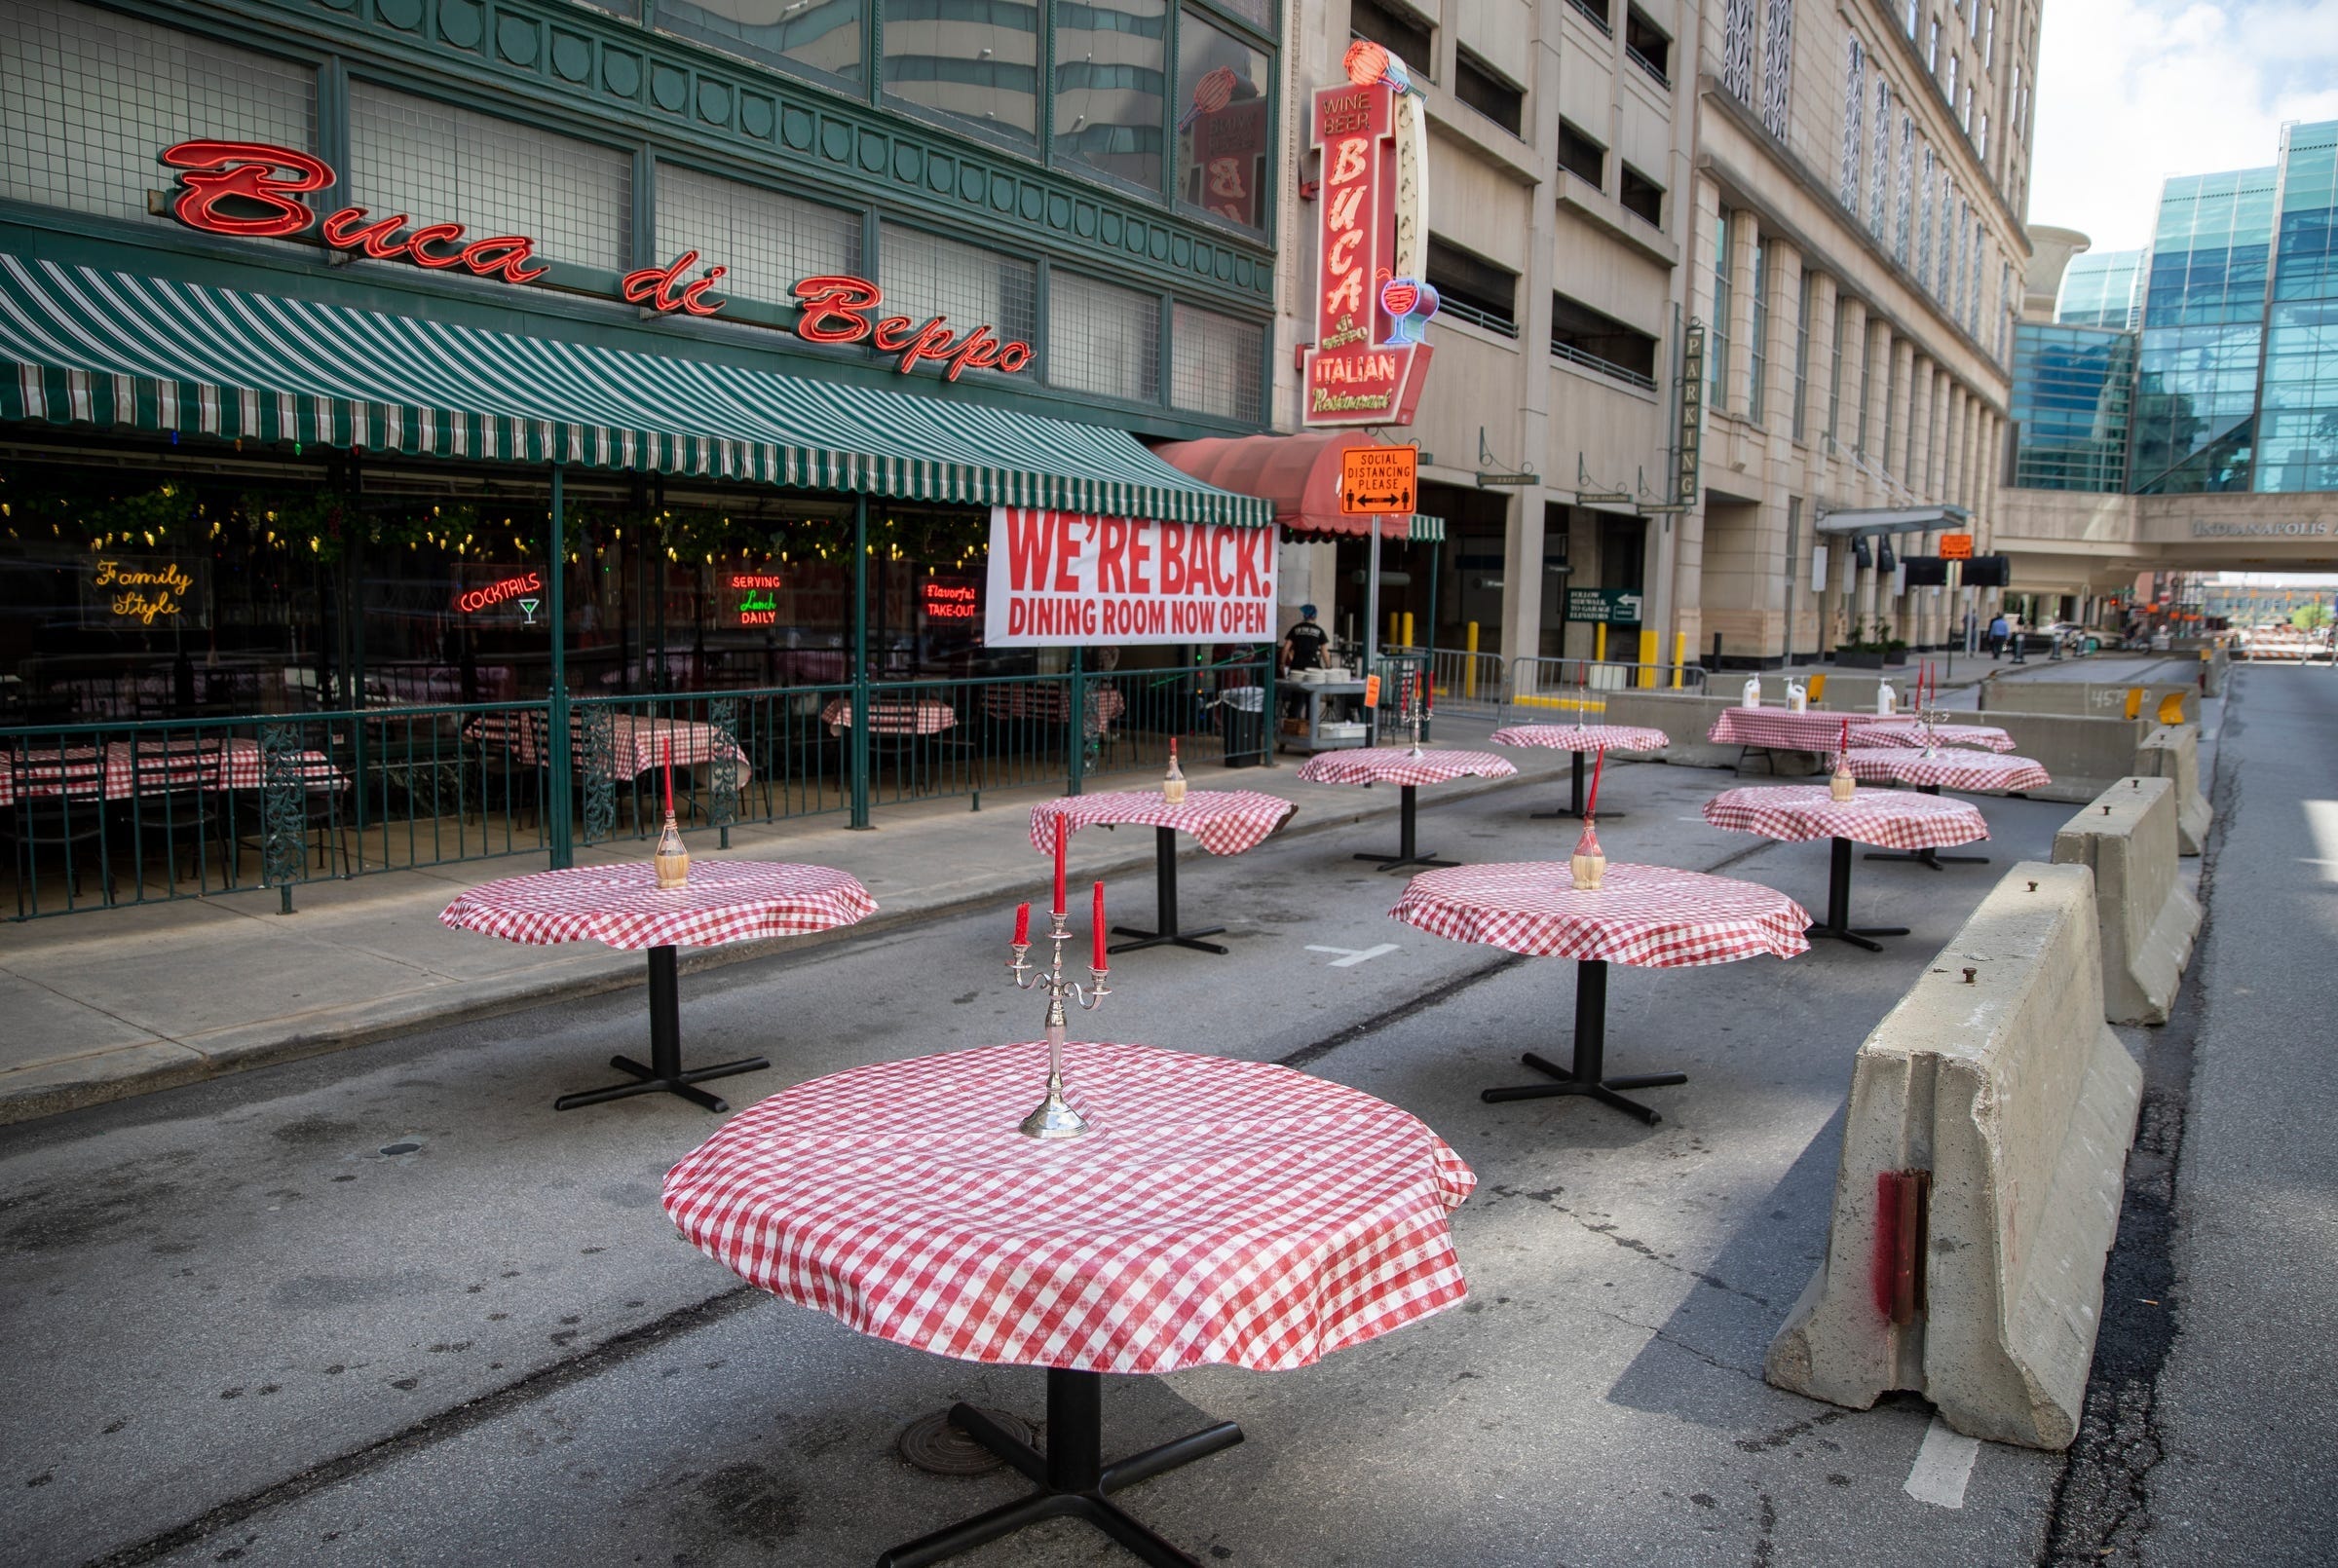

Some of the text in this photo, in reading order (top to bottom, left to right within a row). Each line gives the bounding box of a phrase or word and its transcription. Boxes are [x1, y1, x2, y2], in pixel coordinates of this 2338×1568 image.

[1322, 93, 1372, 116] WINE
[1324, 112, 1372, 136] BEER
[1327, 136, 1369, 316] BUCA
[161, 138, 1037, 382] Buca di Beppo
[1315, 354, 1396, 385] ITALIAN
[1312, 387, 1394, 413] Restaurant
[1681, 339, 1700, 494] PARKING
[1360, 453, 1398, 466] SOCIAL
[1347, 467, 1411, 478] DISTANCING
[1358, 478, 1399, 490] PLEASE
[1006, 504, 1274, 599] WE'RE BACK!
[96, 559, 194, 596] Family
[732, 576, 780, 588] SERVING
[461, 572, 541, 612] COCKTAILS
[739, 588, 777, 611] Lunch
[926, 584, 976, 602] Flavorful
[112, 591, 182, 625] Style
[741, 612, 776, 624] DAILY
[927, 603, 976, 617] TAKE-OUT
[1008, 597, 1266, 636] DINING ROOM NOW OPEN
